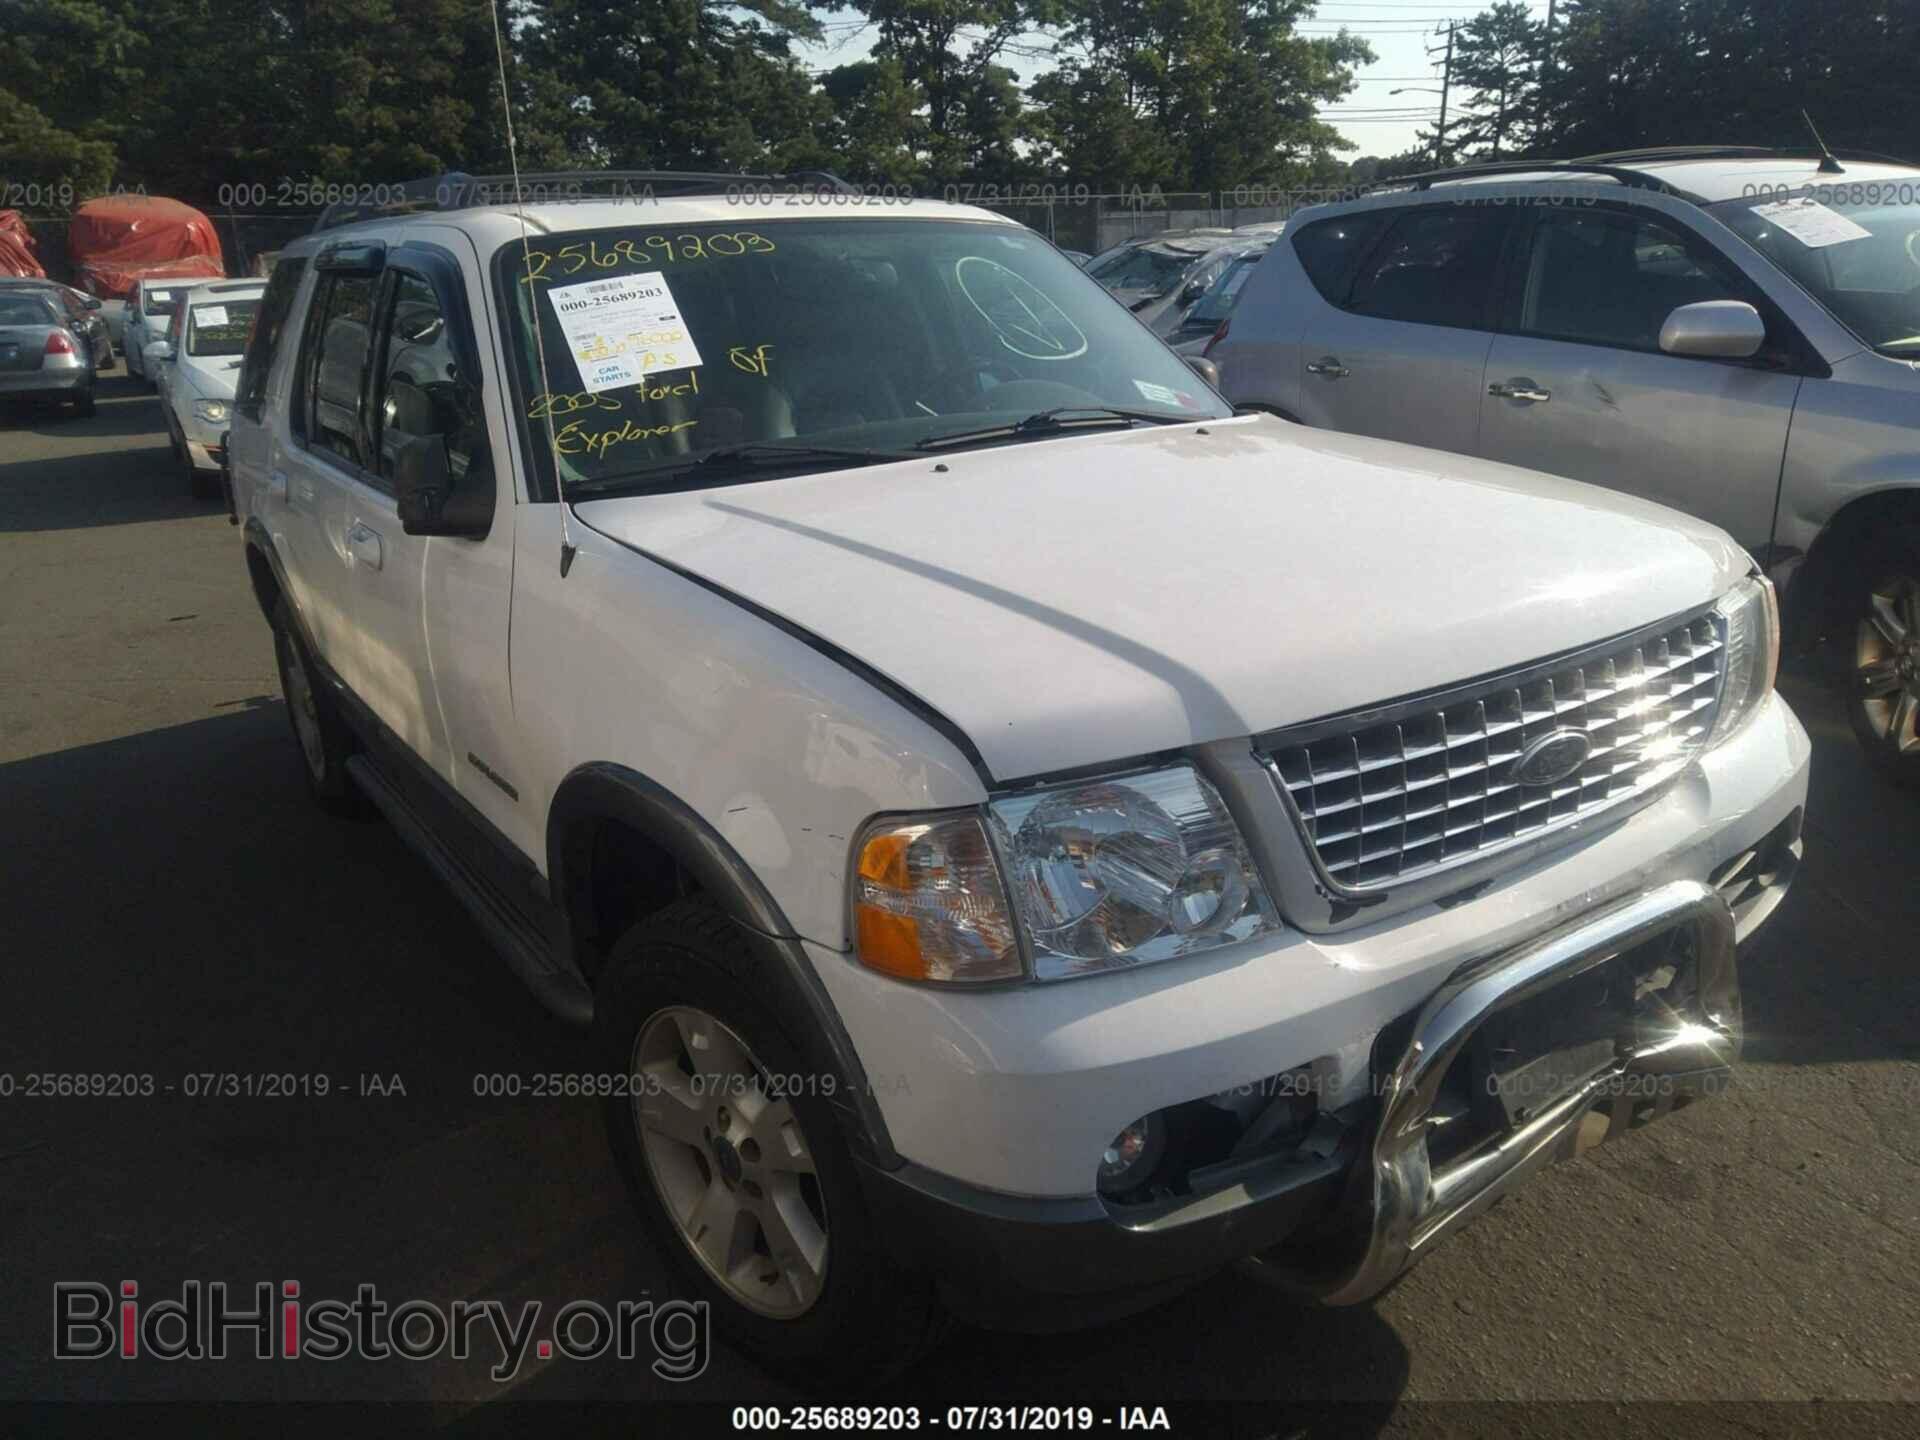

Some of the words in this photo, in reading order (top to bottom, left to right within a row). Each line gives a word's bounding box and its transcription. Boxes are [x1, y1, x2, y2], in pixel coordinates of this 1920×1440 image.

[520, 232, 776, 283] 25689203
[560, 287, 663, 313] 000-25689203
[593, 371, 632, 384] STARTS
[598, 366, 619, 375] CAR
